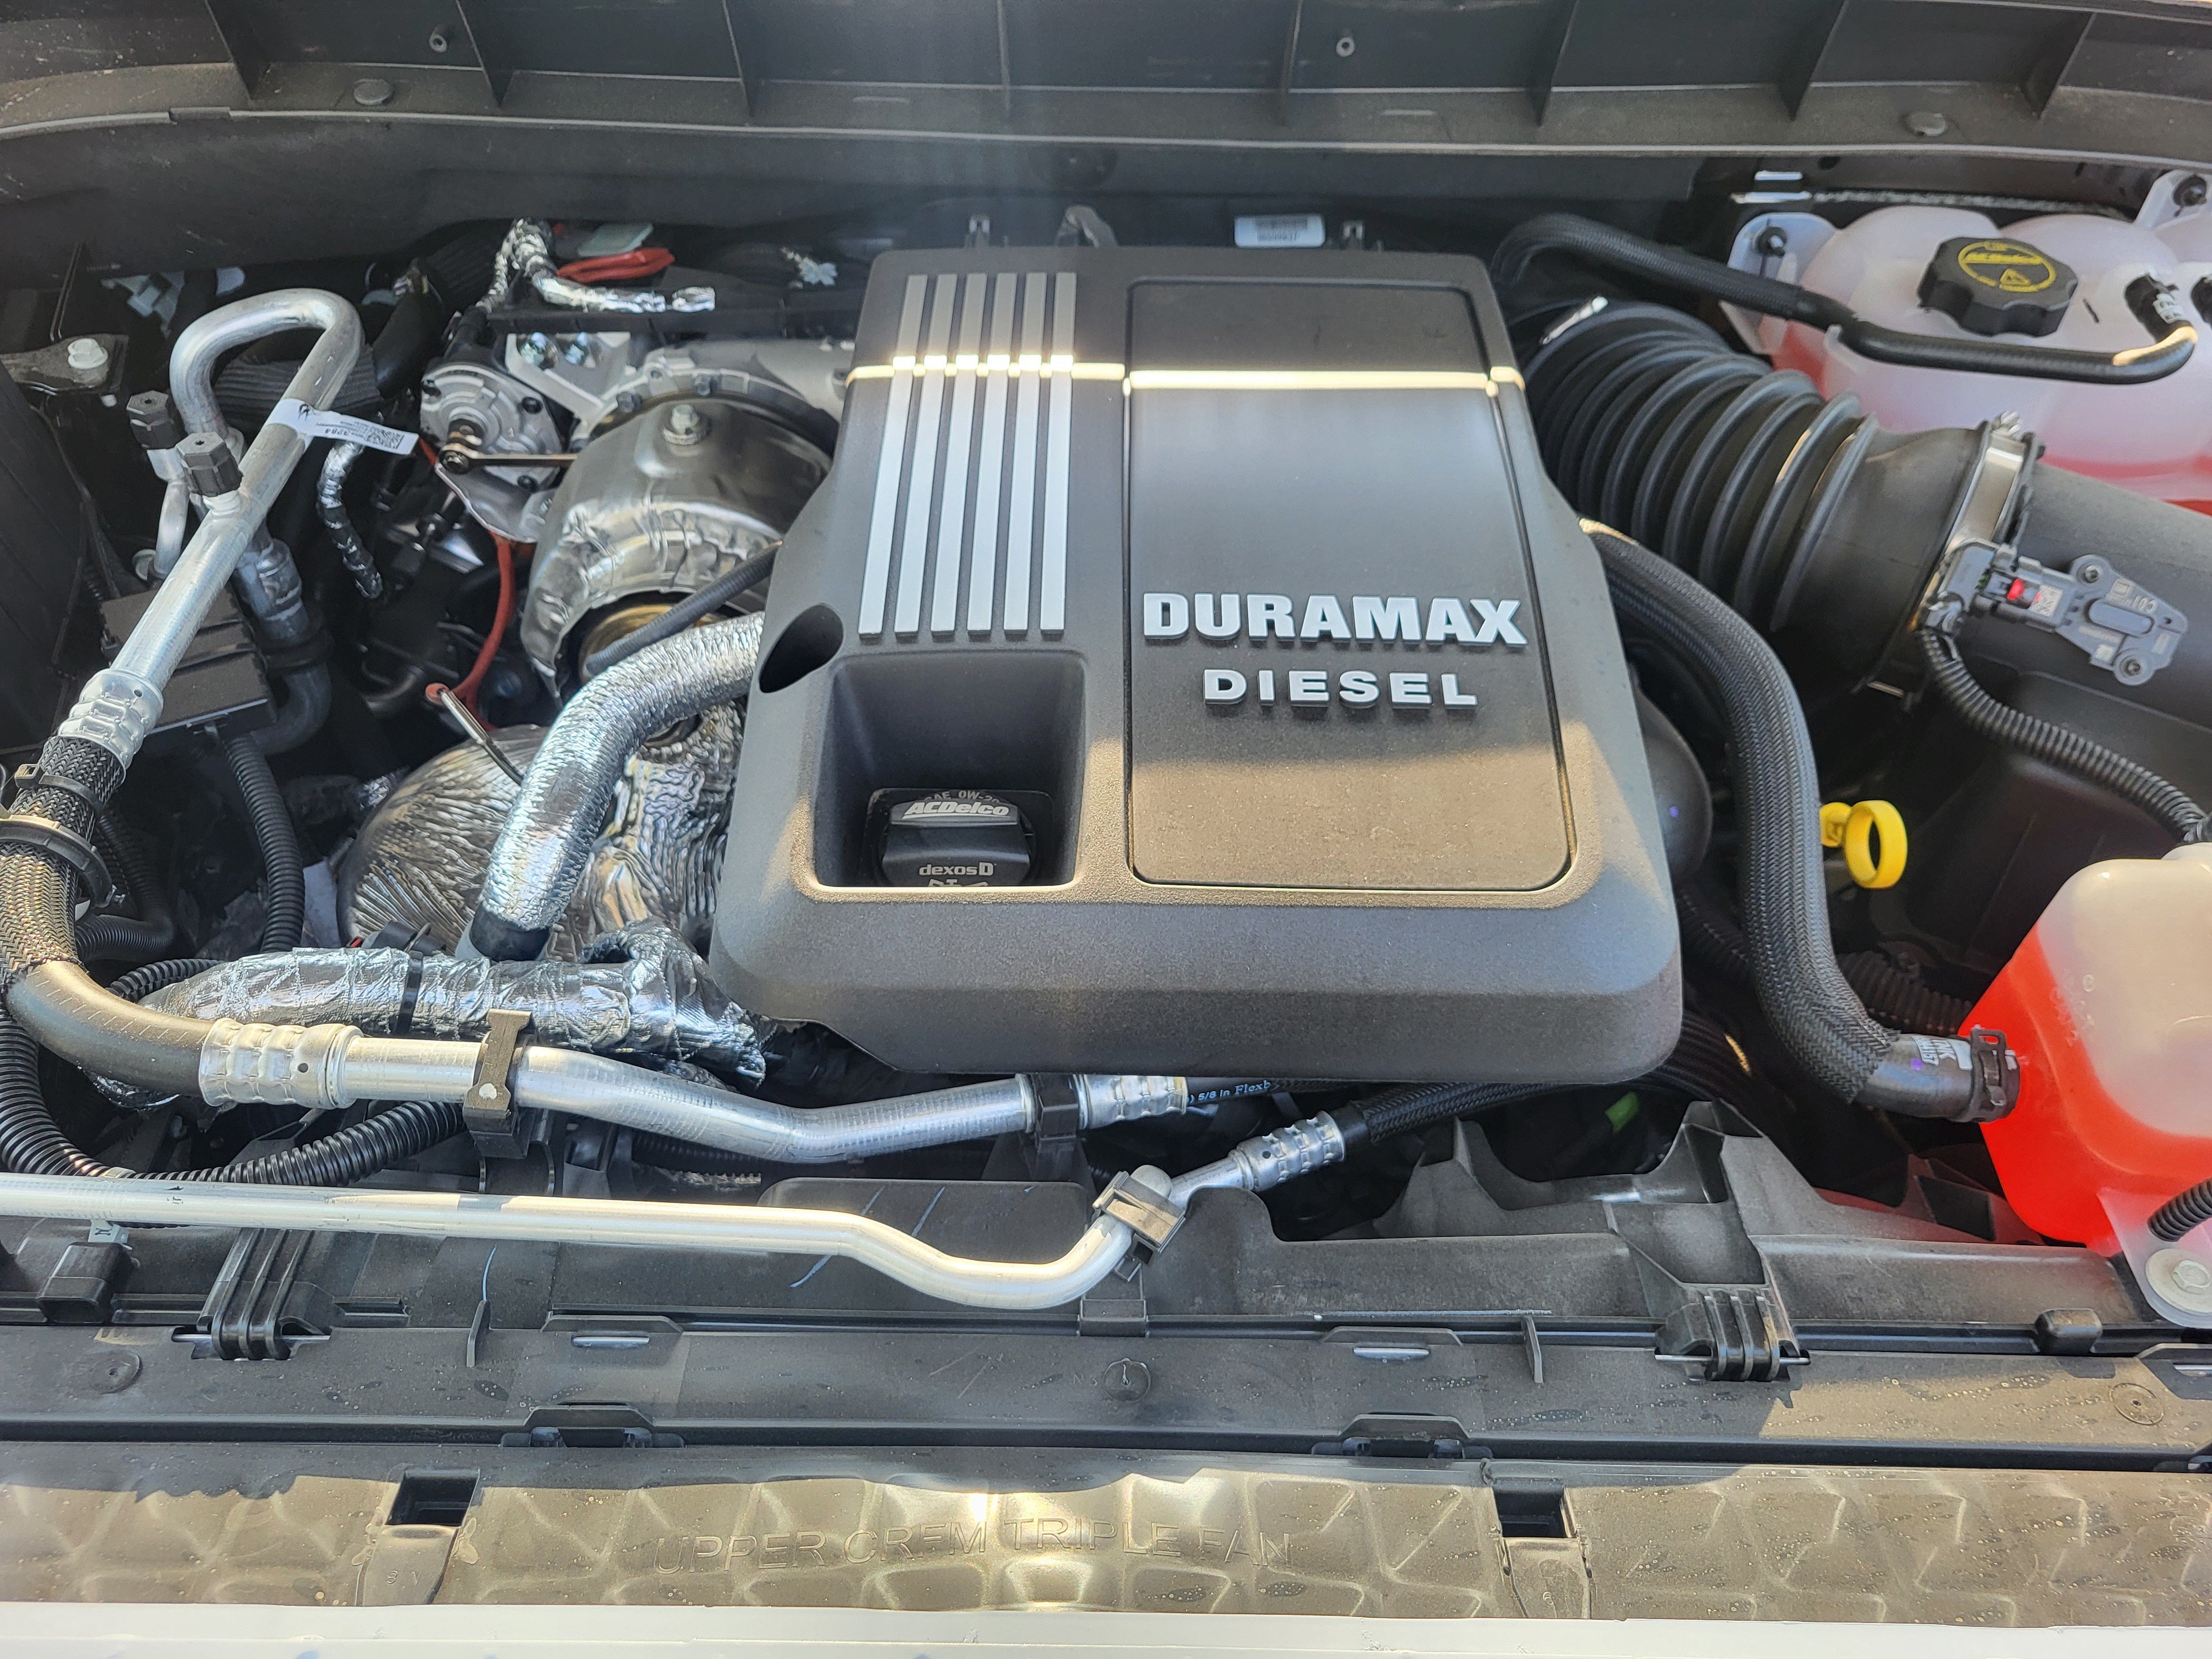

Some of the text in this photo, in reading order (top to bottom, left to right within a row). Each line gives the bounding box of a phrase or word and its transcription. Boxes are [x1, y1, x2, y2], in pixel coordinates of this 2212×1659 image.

[1143, 592, 1528, 647] DURAMAX
[1203, 668, 1478, 709] DIESEL
[904, 801, 1010, 816] ACDelco
[1198, 1091, 1217, 1101] 5/8
[653, 1517, 1293, 1575] UPPER CRFM TRIPLE FAN
